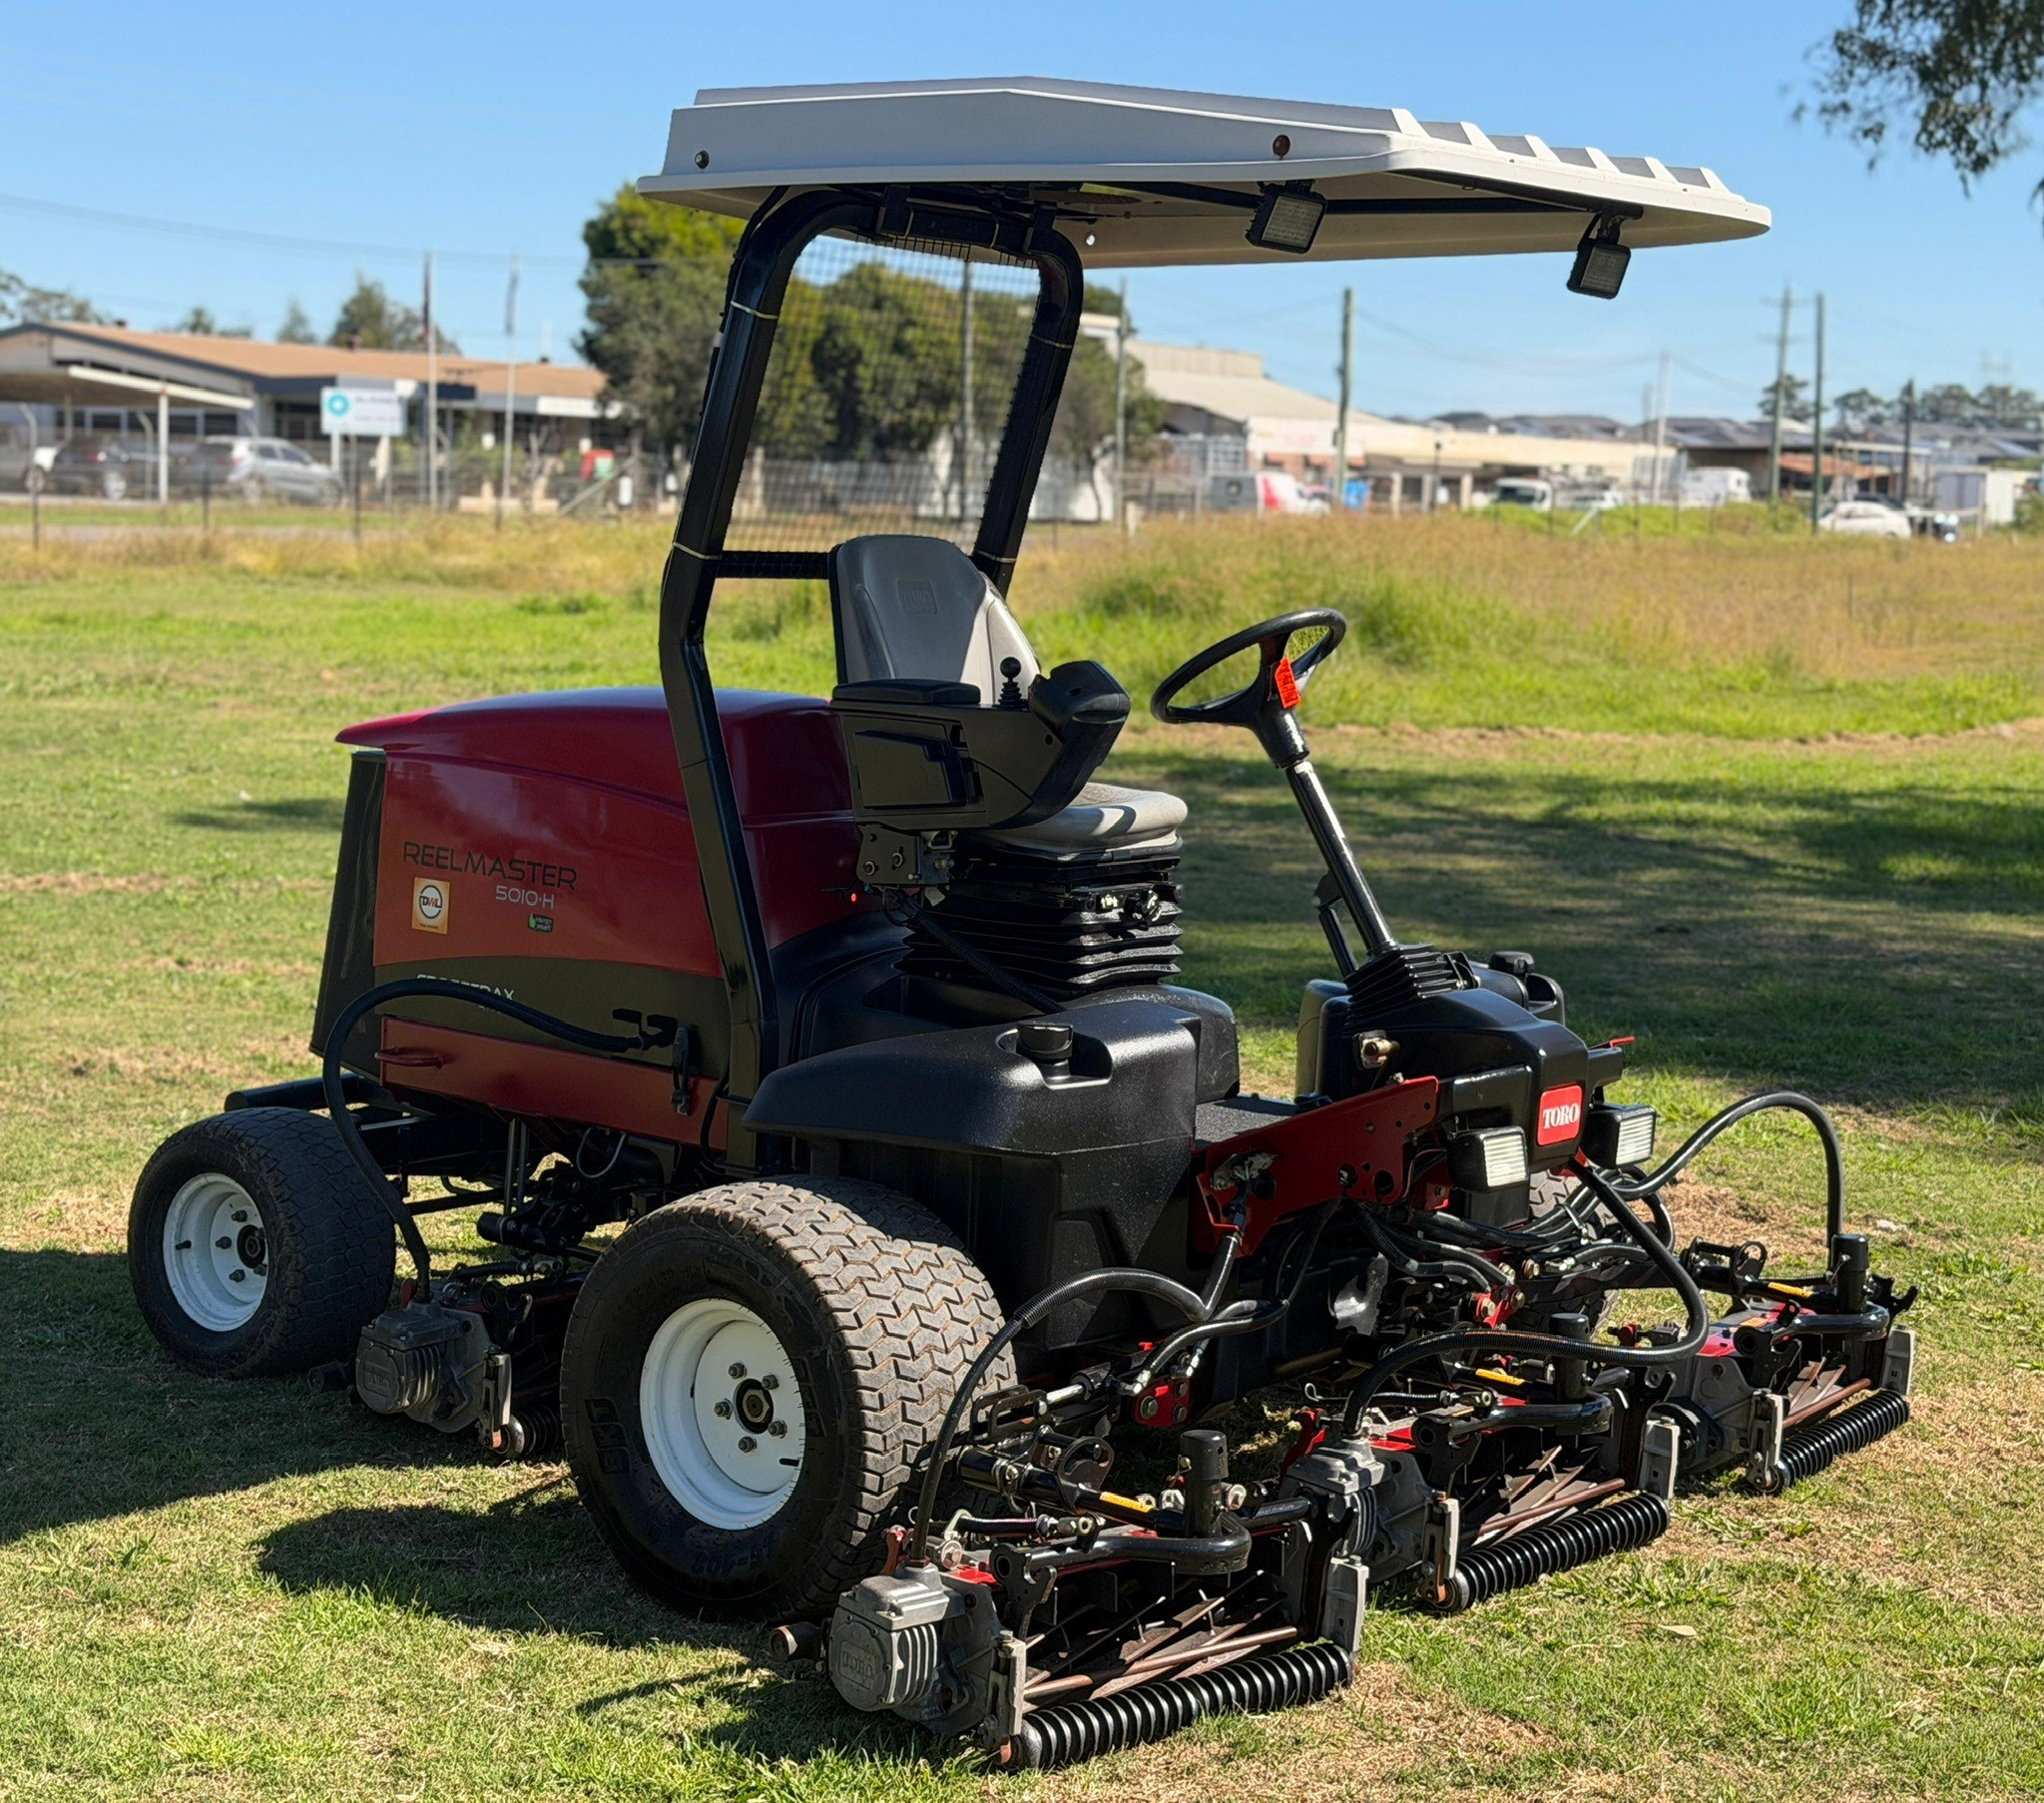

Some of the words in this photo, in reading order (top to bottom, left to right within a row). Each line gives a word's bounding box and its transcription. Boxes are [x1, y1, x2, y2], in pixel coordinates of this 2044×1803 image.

[403, 841, 577, 890] REELMASTER
[1542, 1103, 1581, 1129] TORO
[841, 1650, 876, 1679] TORO
